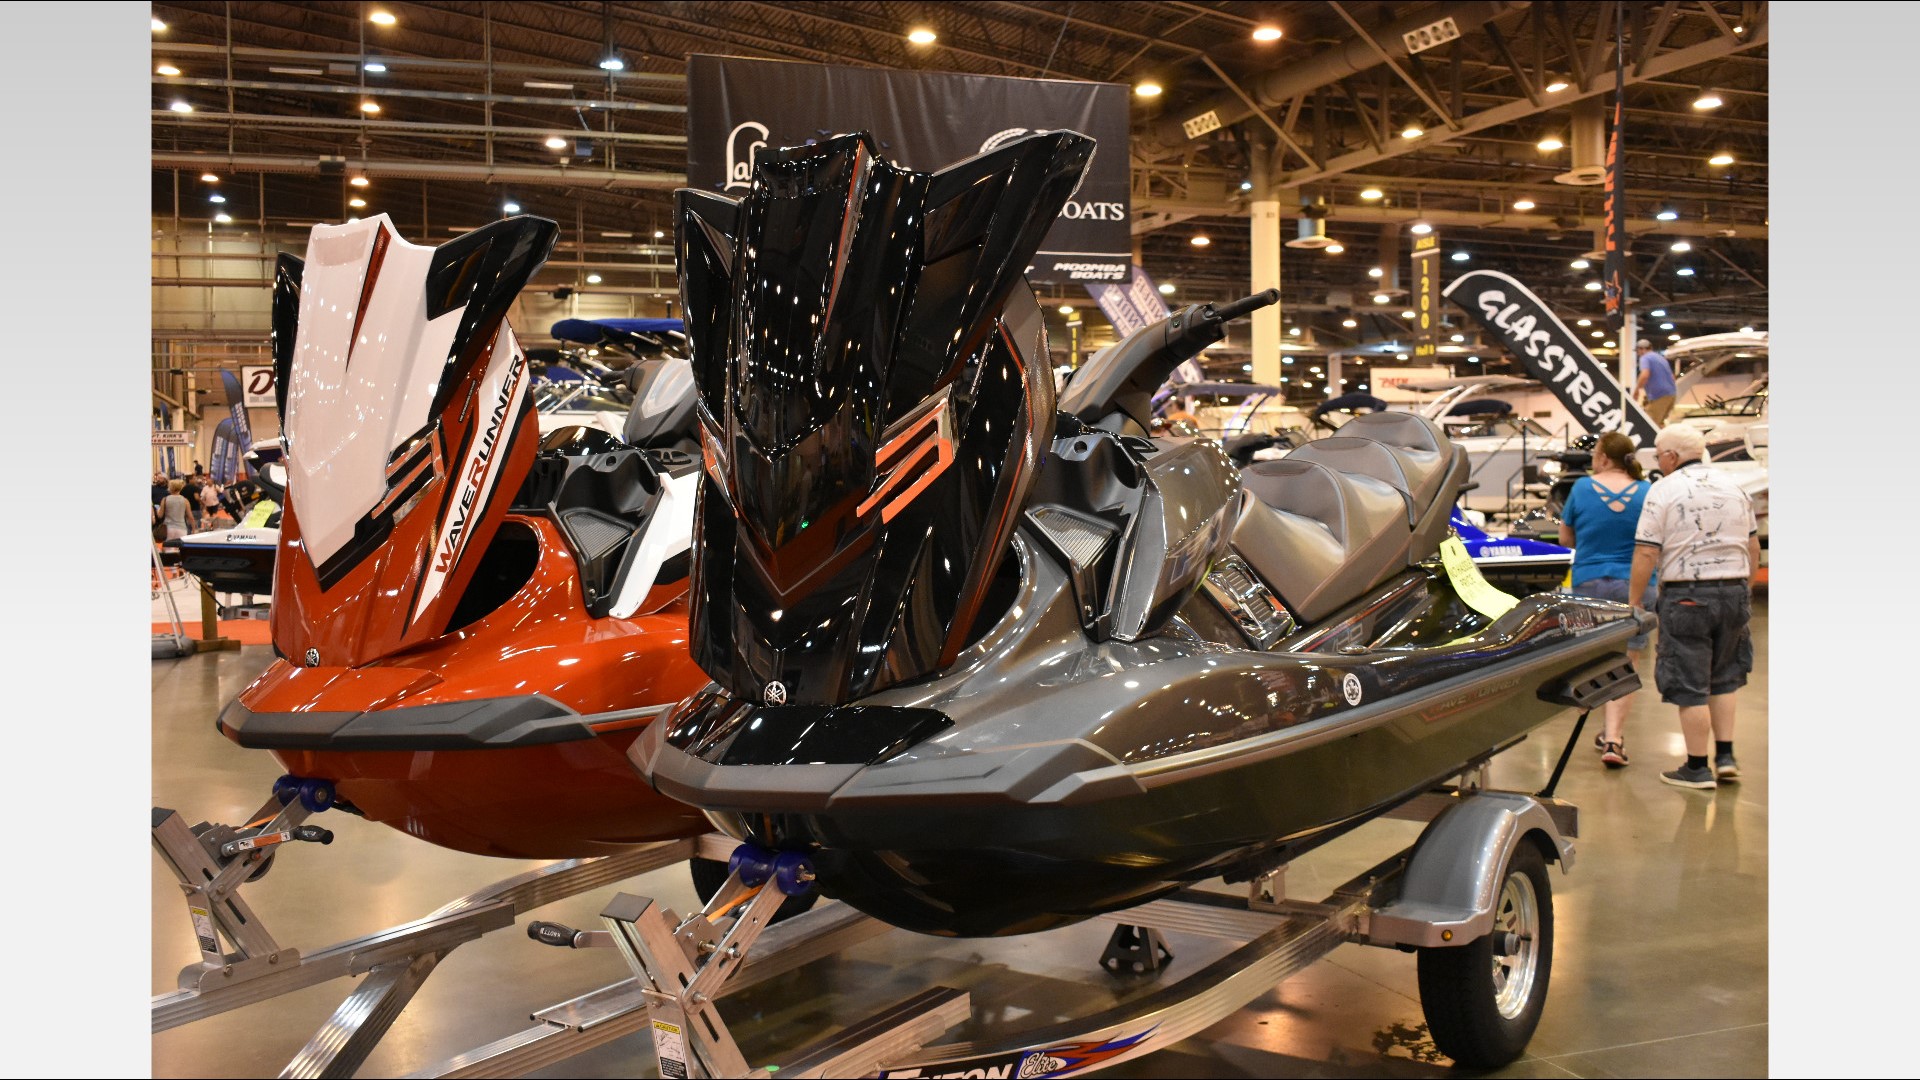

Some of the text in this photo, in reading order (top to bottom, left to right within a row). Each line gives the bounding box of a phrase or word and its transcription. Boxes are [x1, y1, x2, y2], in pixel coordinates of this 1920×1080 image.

[1058, 201, 1125, 221] OATS
[1053, 263, 1126, 272] MOOMBA
[1070, 271, 1125, 280] BOATS
[1420, 258, 1430, 330] 1200
[435, 354, 523, 573] WAVERUNNER
[1489, 545, 1523, 556] YAMAHA
[884, 1051, 1058, 1079] TTON Elite
